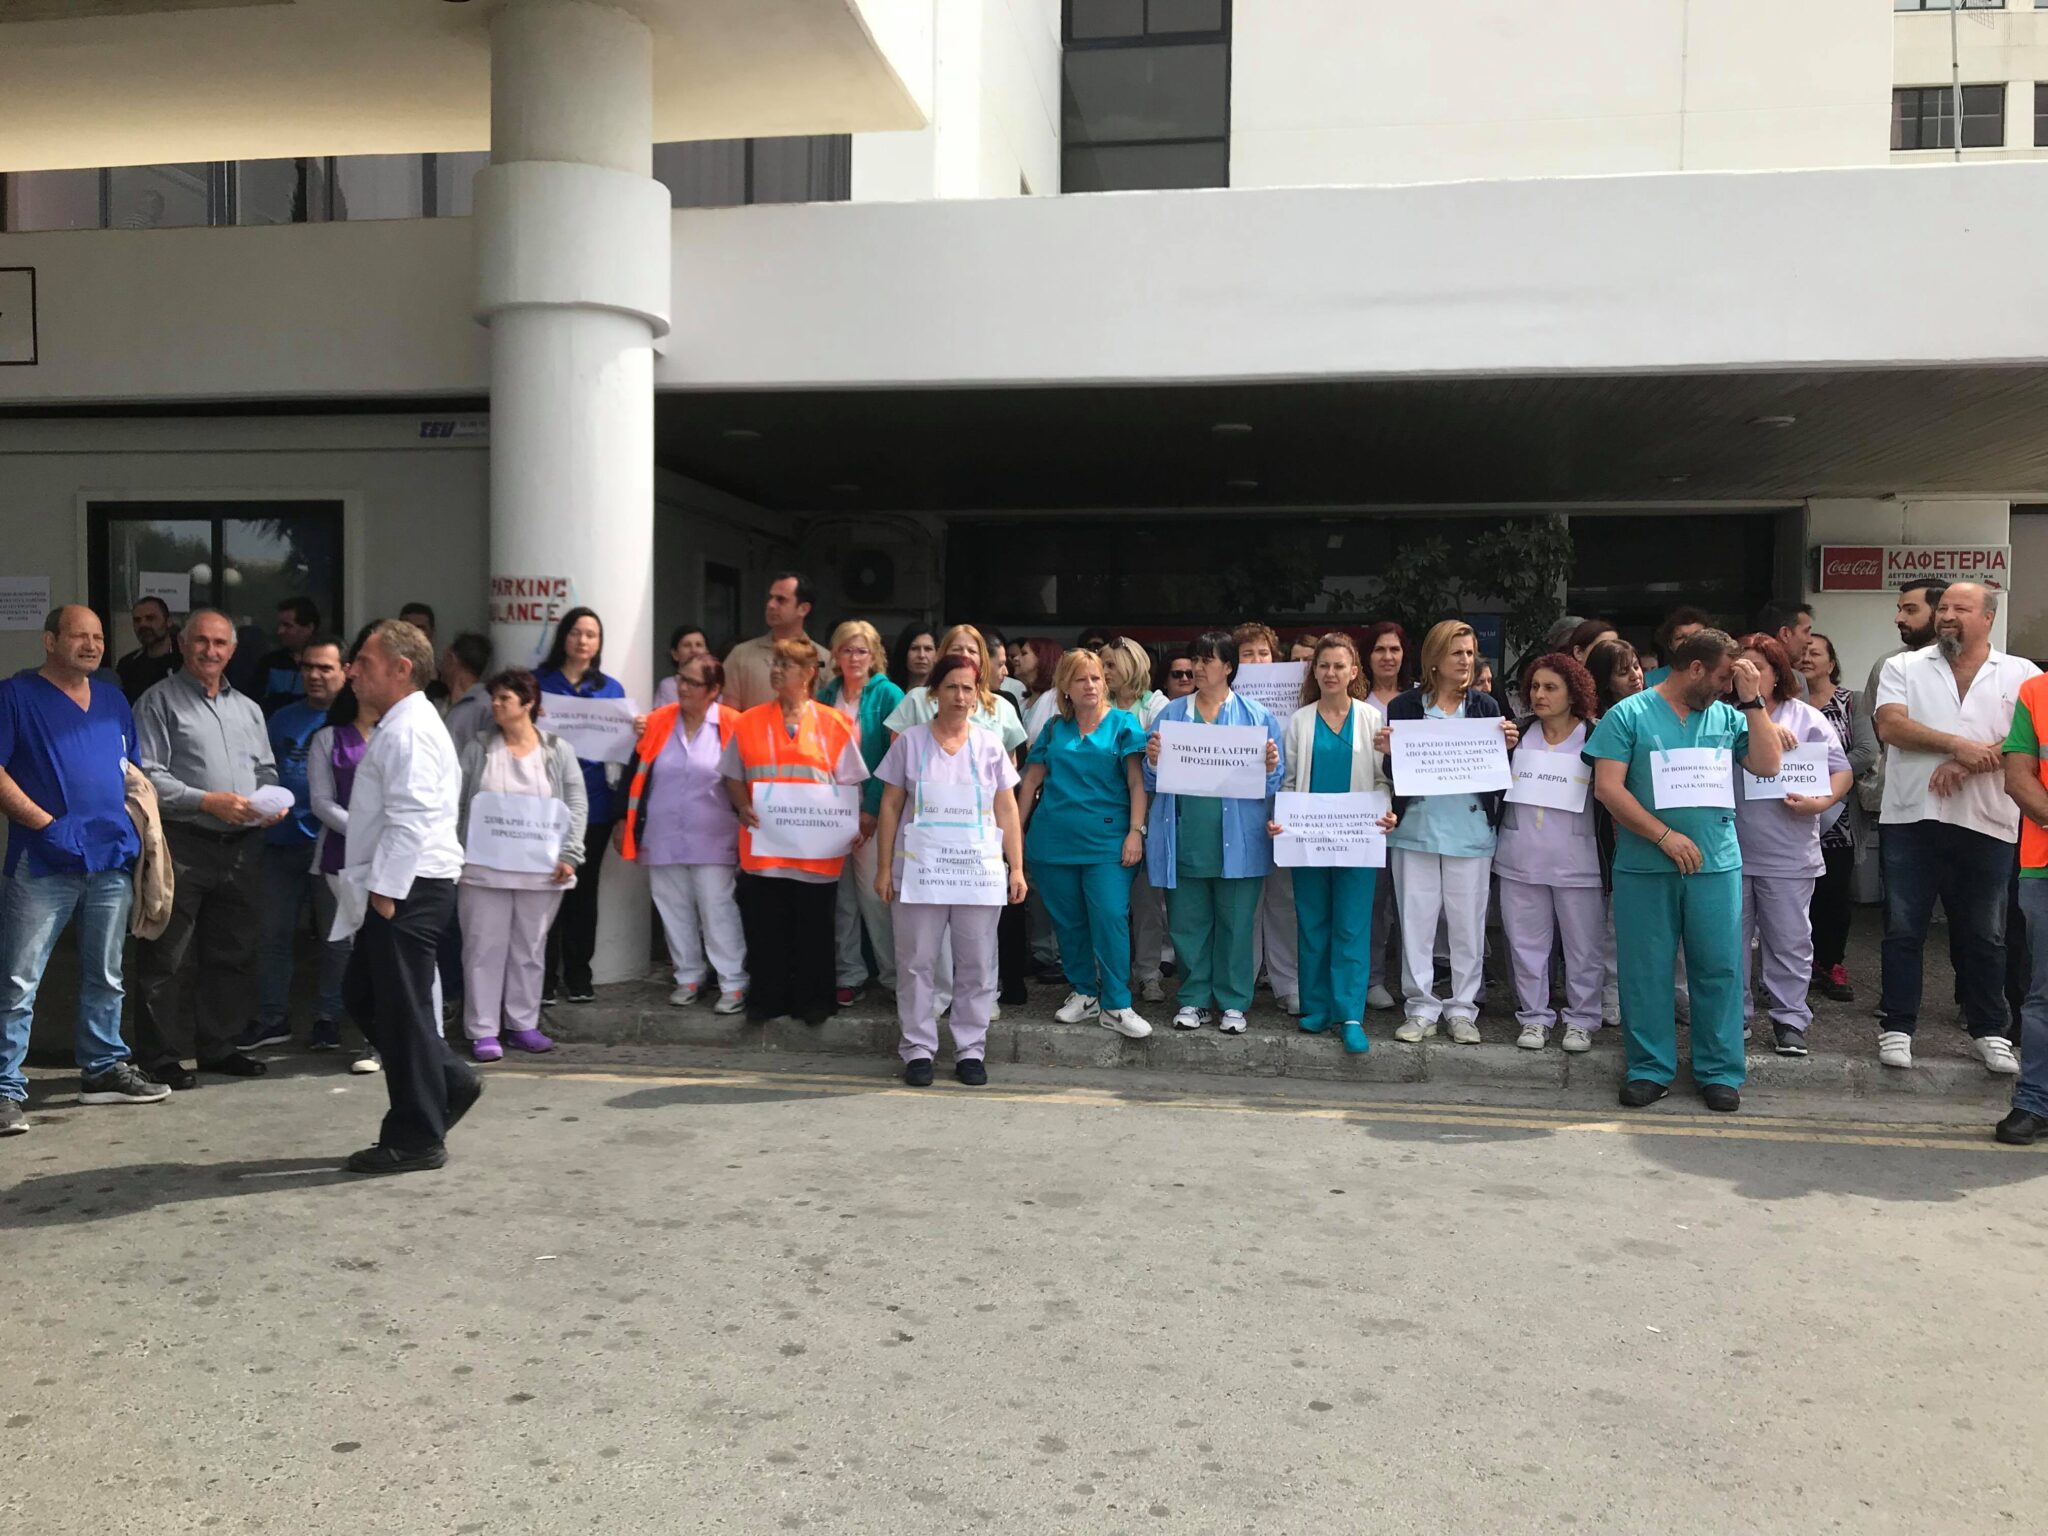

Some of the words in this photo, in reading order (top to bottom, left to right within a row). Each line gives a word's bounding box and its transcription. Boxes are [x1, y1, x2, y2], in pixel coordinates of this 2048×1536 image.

[1888, 551, 2006, 570] ΚΑΦΕΤΕΡΙΑ
[1827, 560, 1879, 575] Coca-Cola
[1172, 743, 1211, 754] ΣΟΒΑΡΗ
[1213, 746, 1258, 755] ΕΛΛΕΙΨΗ
[1180, 755, 1249, 767] ΠΡΟΣΩΠΙΚΟΥ.
[1780, 763, 1815, 771] ΩΠΙΚΟ
[1538, 773, 1568, 783] ΑΠΕΡΓΙΑ
[1756, 775, 1776, 783] ΣΤΟ
[1781, 775, 1817, 783] ΑΡΧΕΙΟ
[767, 805, 807, 814] ΣΟΒΑΡΗ
[809, 807, 852, 817] ΕΛΛΕΙΨΗ
[944, 807, 973, 815] ΑΠΕΡΓΙΑ
[1327, 812, 1379, 820] ΠΛΗΜΜΥΡΙΖΕΙ
[919, 878, 958, 887] ΠΑΡΟΥΜΕ
[960, 879, 972, 887] ΤΙΣ
